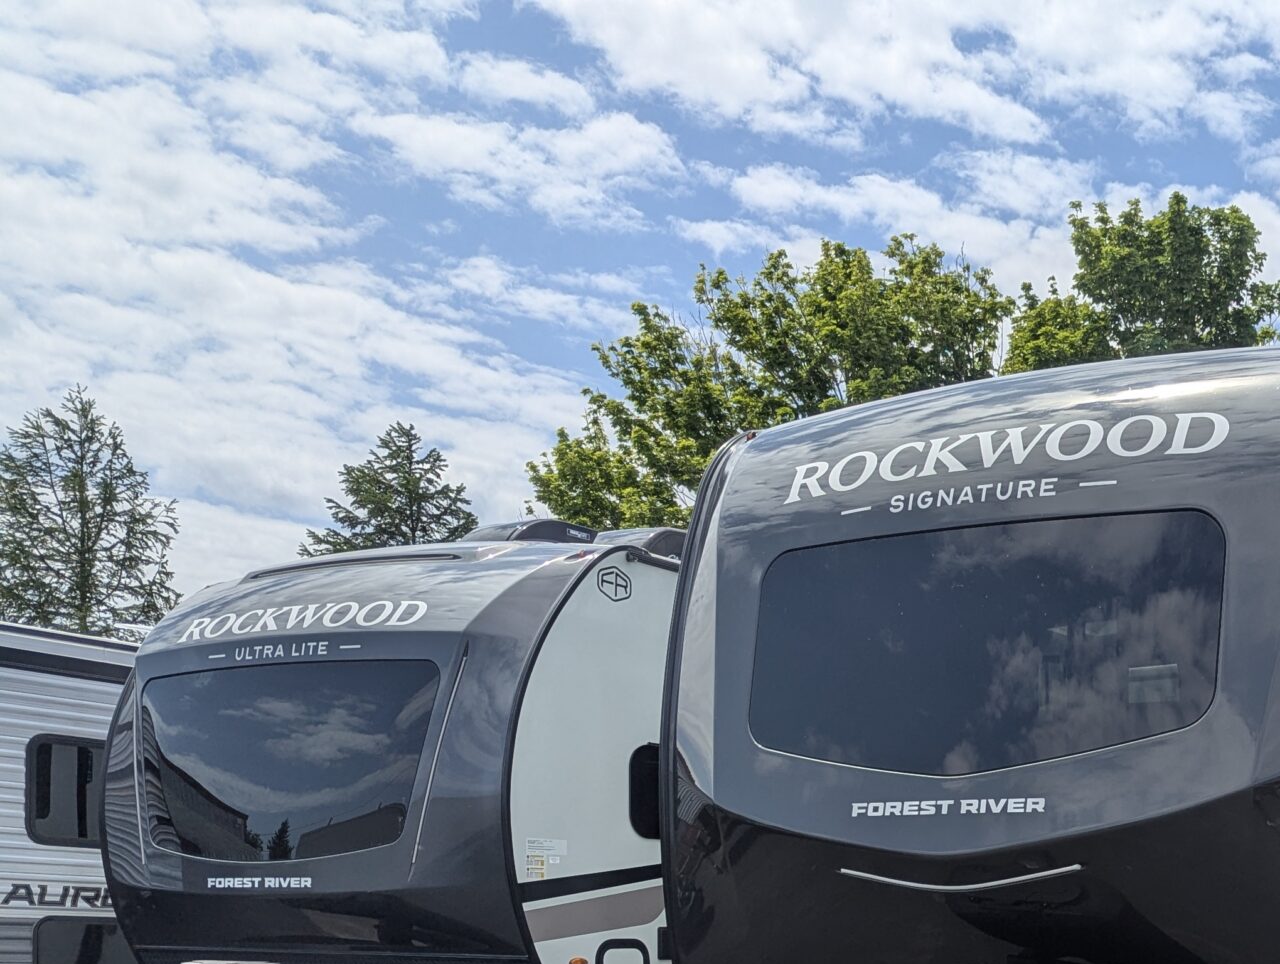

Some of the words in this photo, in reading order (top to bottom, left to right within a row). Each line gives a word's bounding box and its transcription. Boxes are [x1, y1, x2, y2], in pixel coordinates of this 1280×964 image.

[783, 412, 1230, 504] ROCKWOOD
[889, 477, 1059, 513] SIGNATURE
[177, 600, 428, 643] ROCKWOOD
[234, 644, 284, 661] ULTRA
[291, 641, 329, 656] LITE
[851, 800, 954, 817] FOREST
[960, 798, 1046, 814] RIVER
[207, 878, 261, 889] FOREST
[264, 877, 312, 889] RIVER
